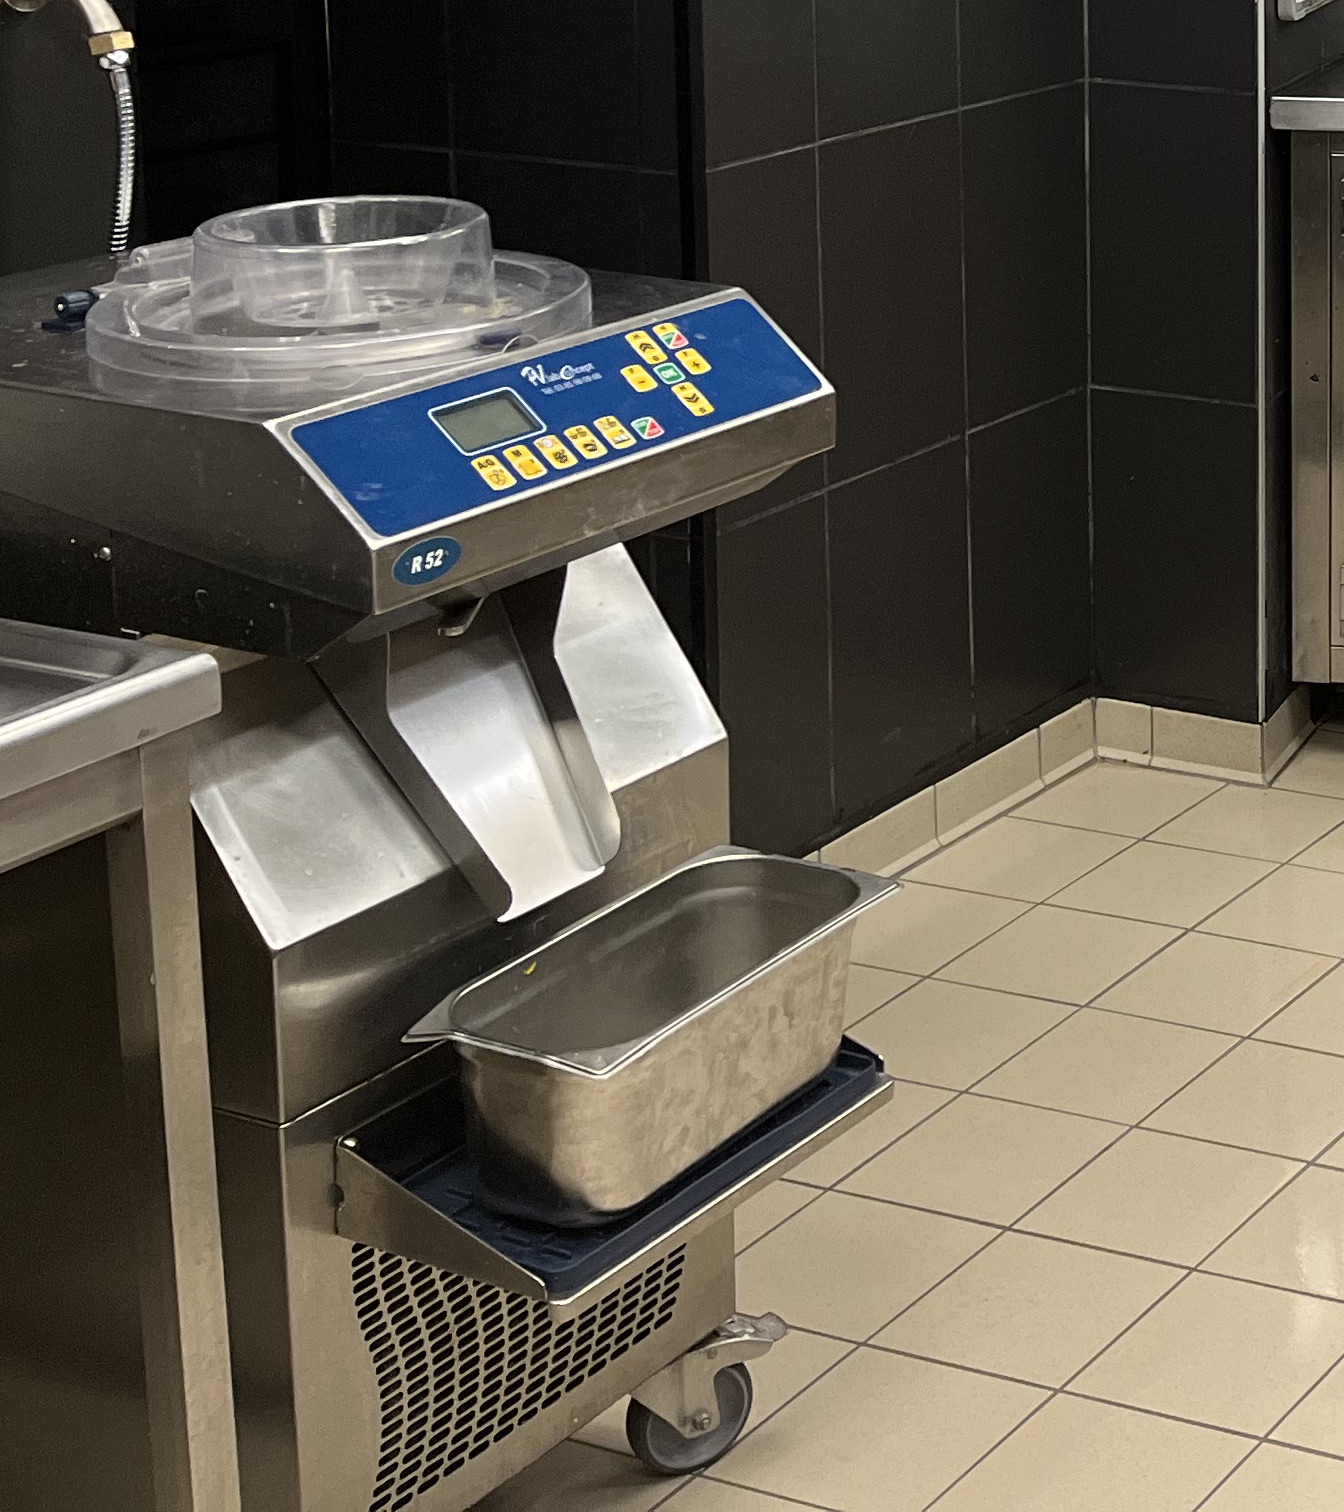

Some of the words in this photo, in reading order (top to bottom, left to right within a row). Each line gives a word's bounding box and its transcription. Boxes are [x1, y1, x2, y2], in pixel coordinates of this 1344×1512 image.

[660, 368, 678, 379] OK
[410, 555, 423, 574] R
[424, 548, 444, 570] 52
